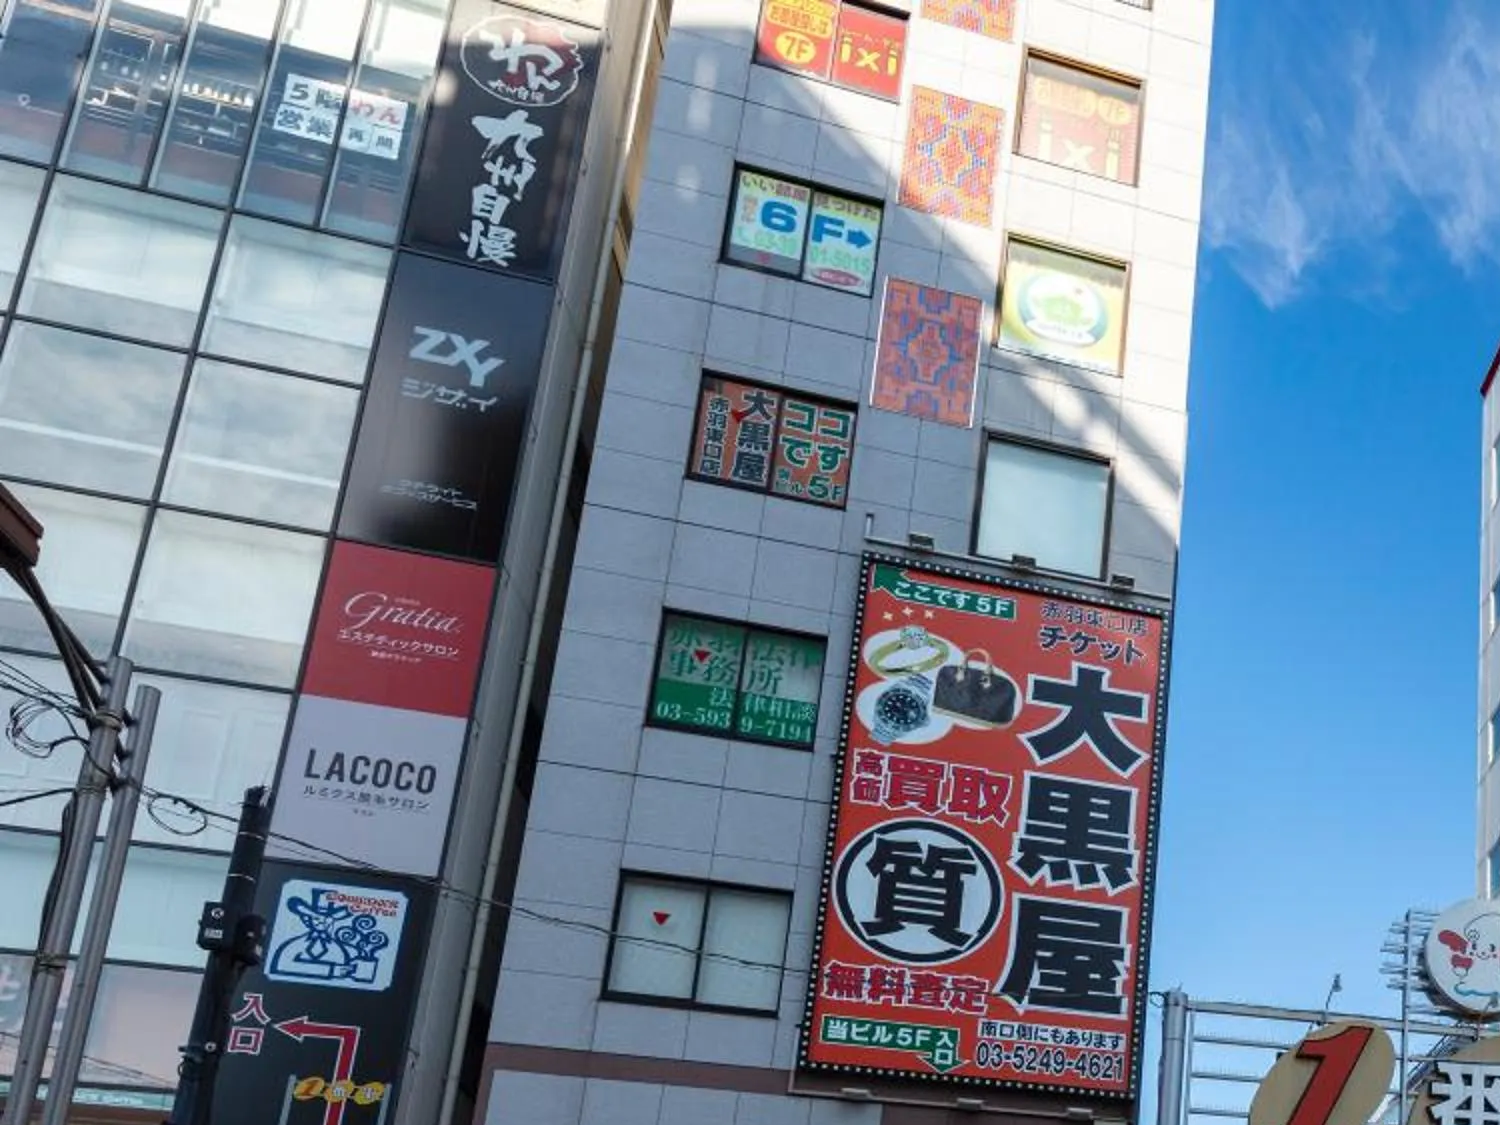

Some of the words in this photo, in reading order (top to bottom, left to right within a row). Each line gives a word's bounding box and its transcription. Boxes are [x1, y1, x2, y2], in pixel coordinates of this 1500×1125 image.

[841, 37, 898, 77] ixi
[459, 110, 545, 268] 九州自慢
[409, 326, 505, 387] ZXY
[731, 389, 775, 484] 大黒屋
[786, 401, 851, 440] ココ
[781, 435, 846, 472] です
[894, 581, 967, 609] ここです
[975, 600, 1011, 618] 5F
[337, 627, 460, 657] エステティックサロン
[1038, 625, 1146, 665] チケット
[670, 649, 783, 695] 事務所
[303, 748, 438, 794] LACOCO
[994, 661, 1151, 1020] 大黒屋
[859, 834, 979, 951] 質
[823, 960, 989, 1015] 無料査定
[228, 992, 271, 1056] 入口
[826, 1018, 932, 1049] 当ビル5F
[976, 1040, 1125, 1082] 03-5249-4621
